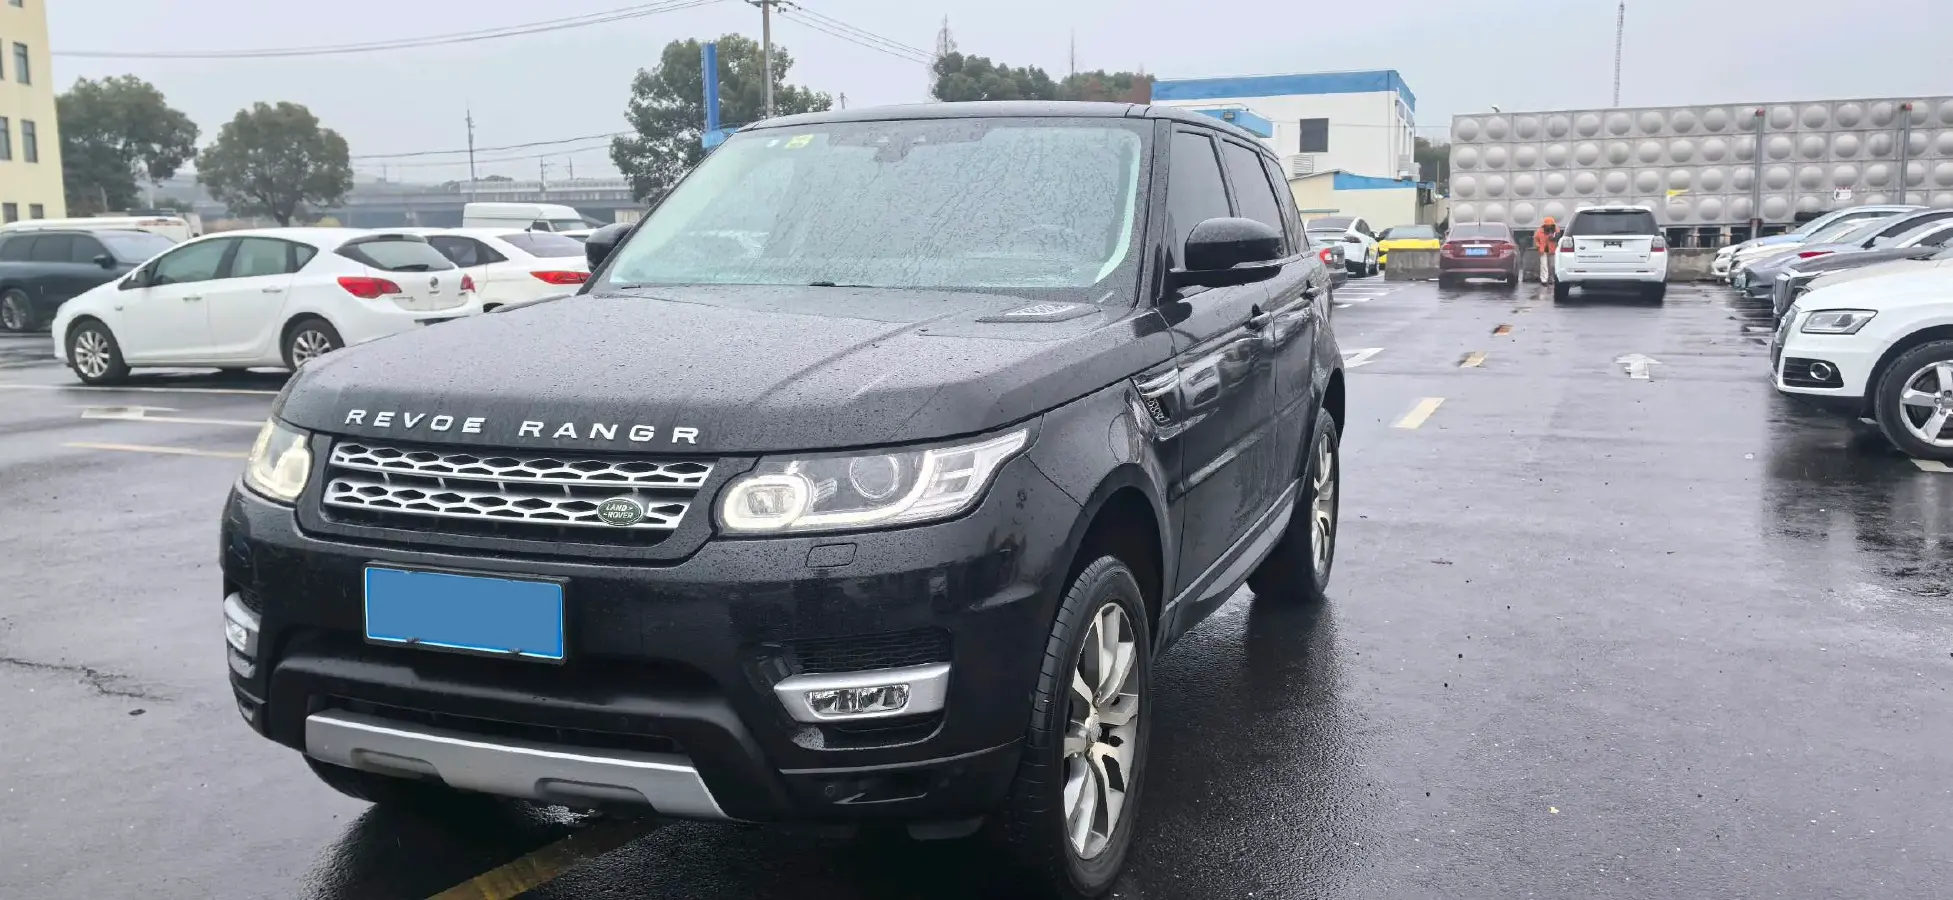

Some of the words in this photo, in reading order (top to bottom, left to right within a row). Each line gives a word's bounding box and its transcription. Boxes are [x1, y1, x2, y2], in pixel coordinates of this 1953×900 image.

[344, 409, 487, 434] REVOE
[518, 420, 699, 444] RANGR
[605, 503, 628, 512] LAND
[607, 511, 634, 519] ROVER
